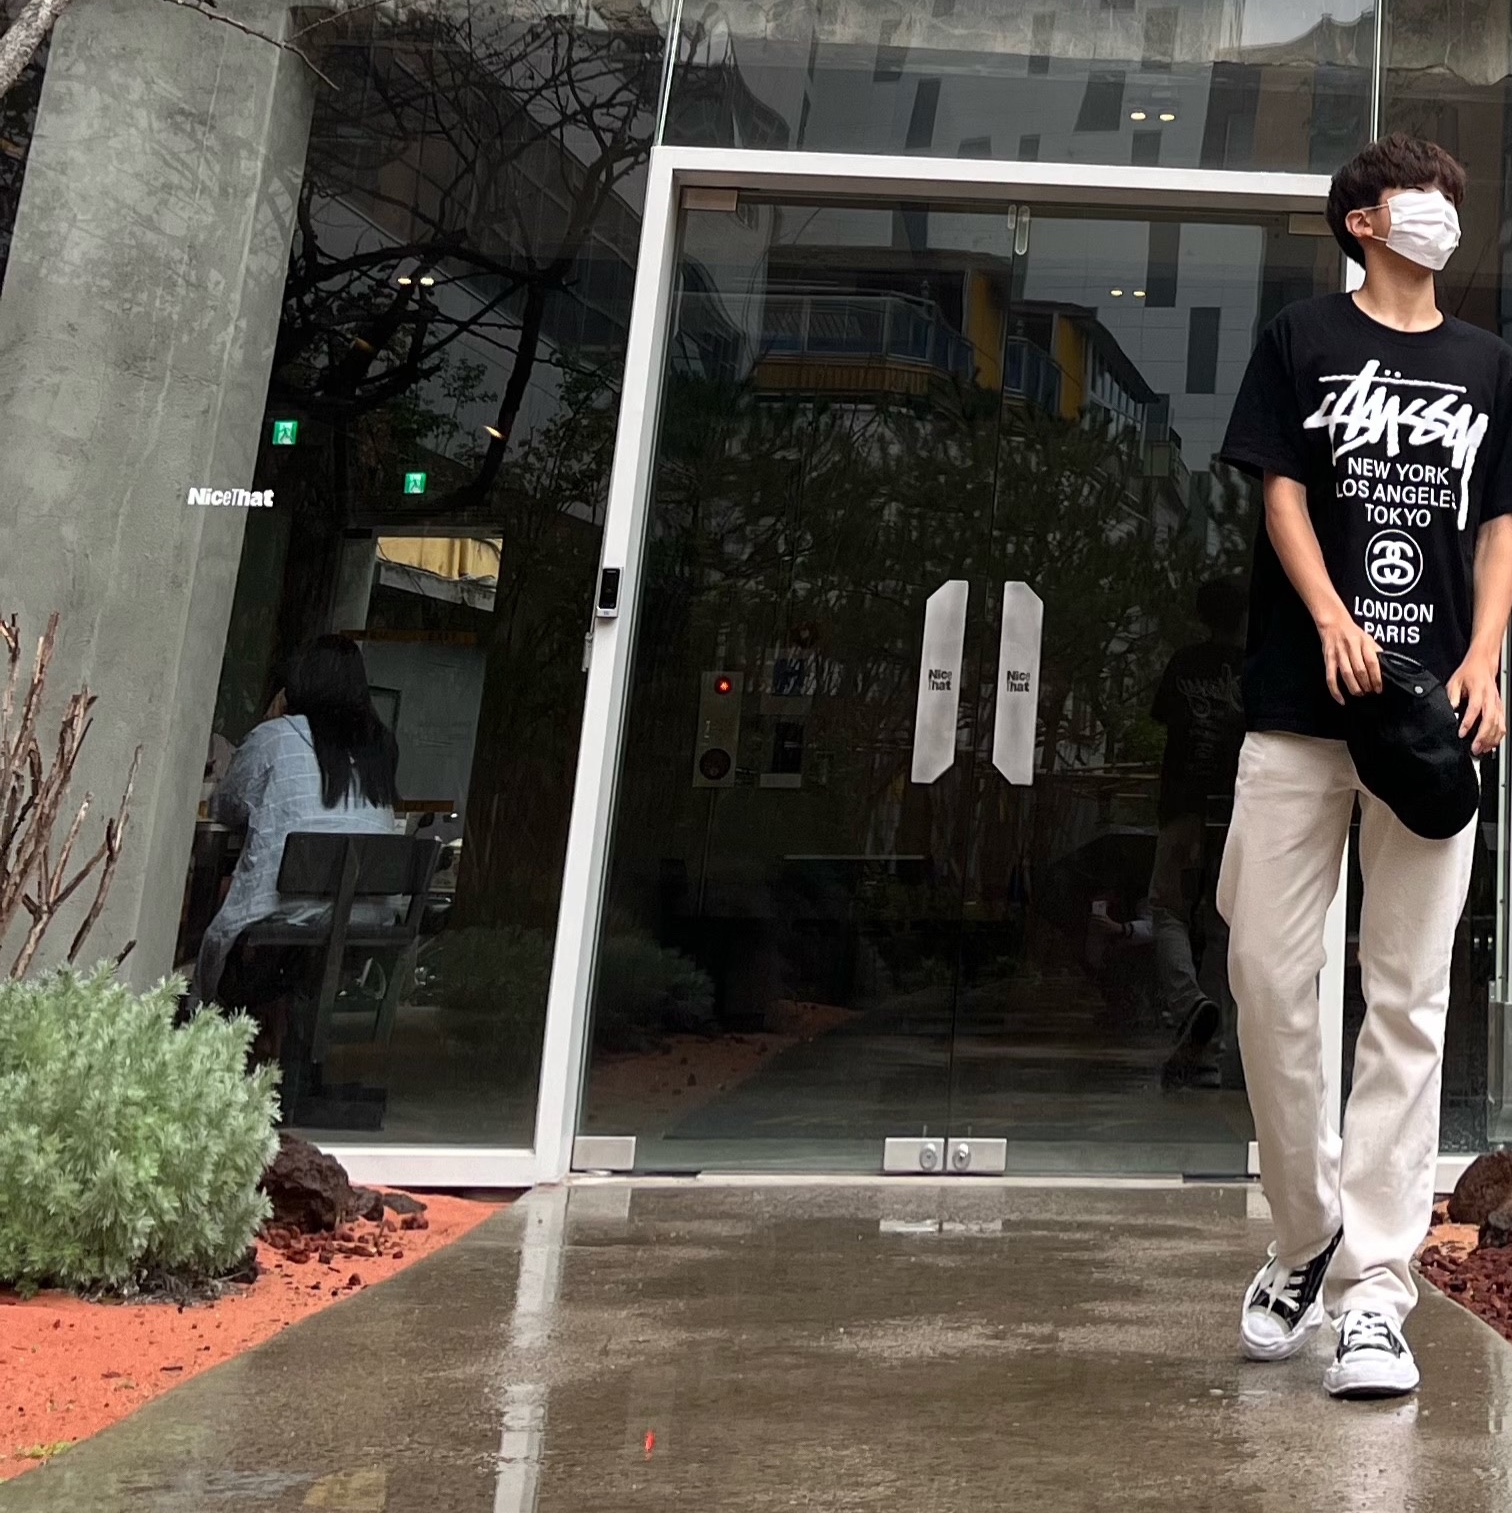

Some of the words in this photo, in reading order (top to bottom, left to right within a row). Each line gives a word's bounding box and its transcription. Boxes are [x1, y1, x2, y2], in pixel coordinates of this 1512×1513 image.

[1348, 457, 1391, 479] NEW
[1396, 463, 1449, 485] YORK
[187, 487, 275, 507] NiceThat
[1336, 478, 1370, 498] LOS
[1365, 503, 1431, 527] TOKYO
[1354, 596, 1434, 623] LONDON
[1364, 621, 1420, 644] PARIS
[929, 669, 953, 680] Nice
[1007, 670, 1030, 681] Nice
